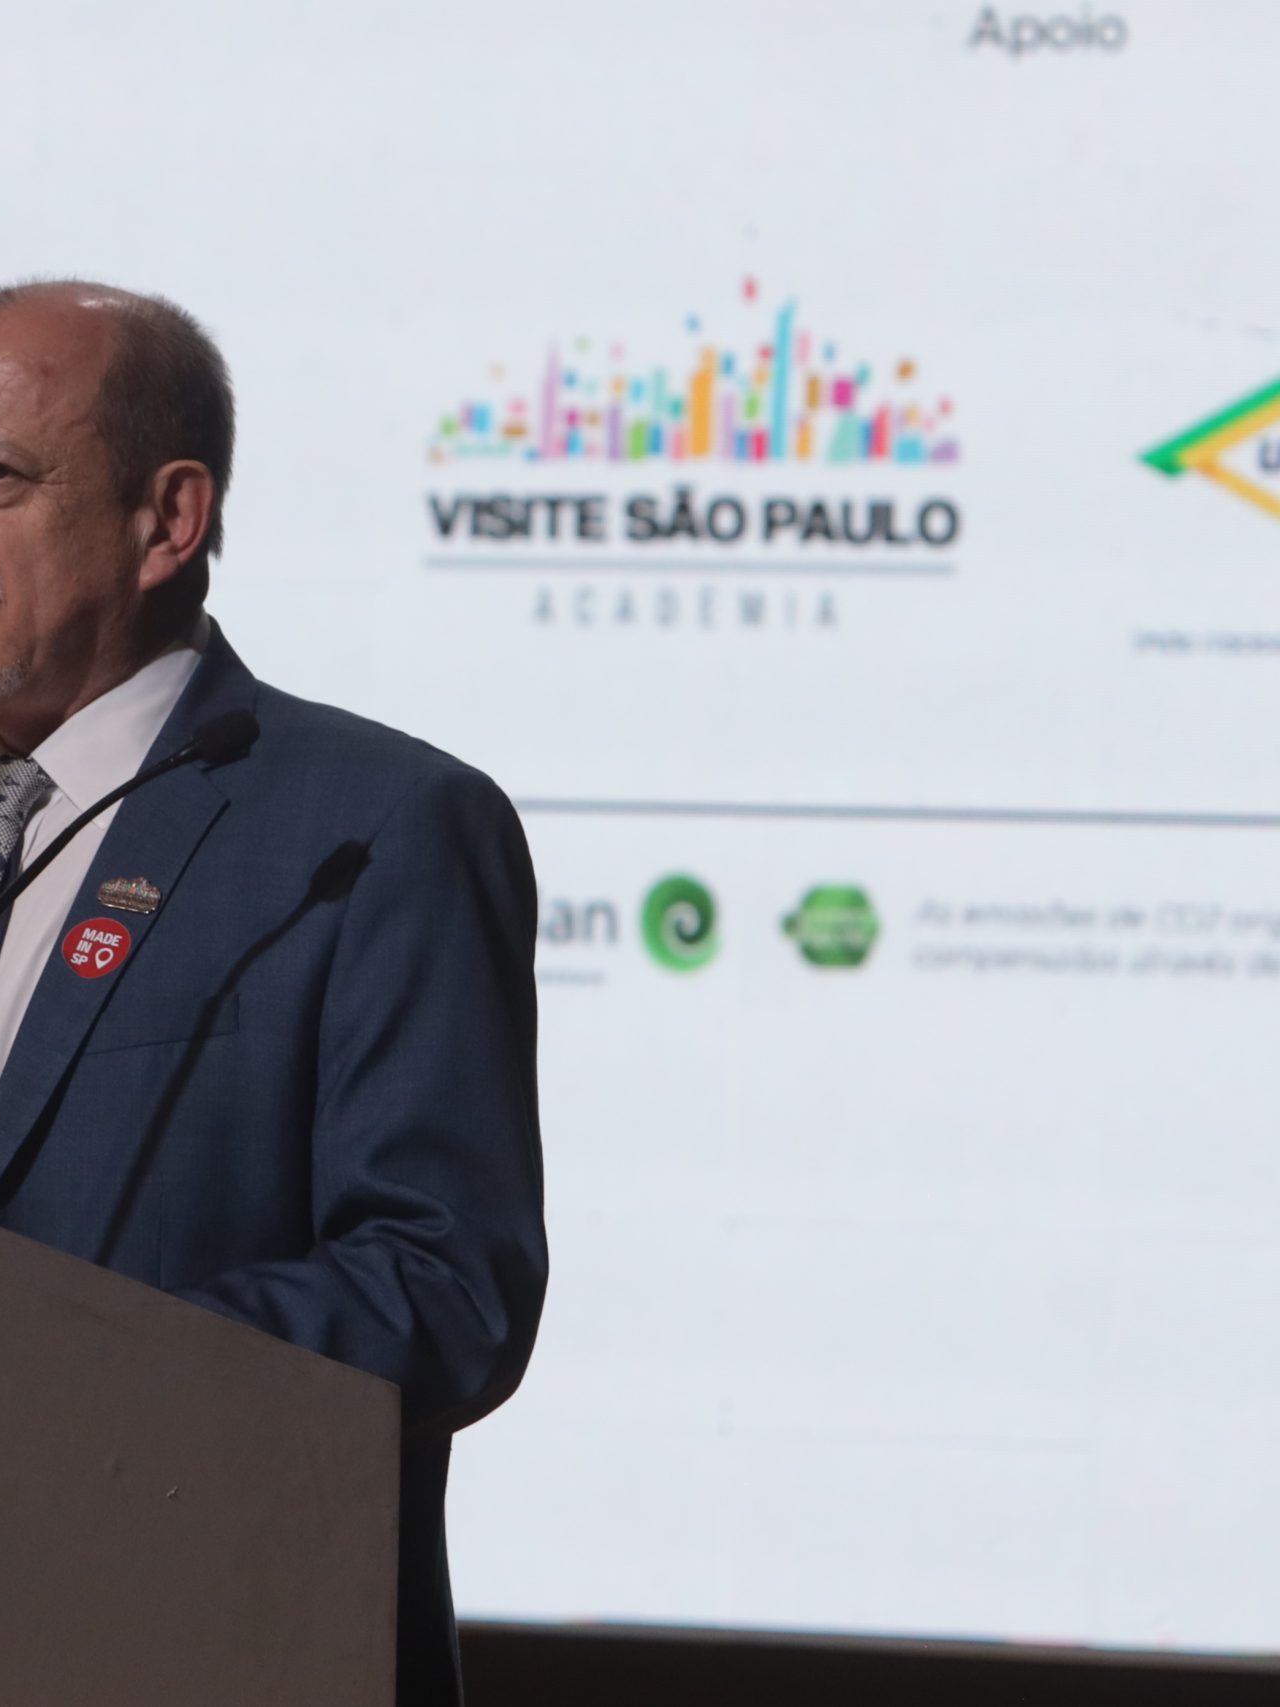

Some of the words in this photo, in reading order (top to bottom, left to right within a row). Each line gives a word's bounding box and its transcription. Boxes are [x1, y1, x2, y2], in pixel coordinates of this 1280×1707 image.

[968, 6, 1127, 57] Apoio
[430, 494, 605, 541] VISITE
[624, 486, 748, 544] SÃO
[761, 498, 960, 547] PAULO
[532, 585, 838, 630] ACADEMIA
[76, 940, 92, 953] IN
[82, 928, 122, 947] MADE
[70, 953, 88, 965] SP
